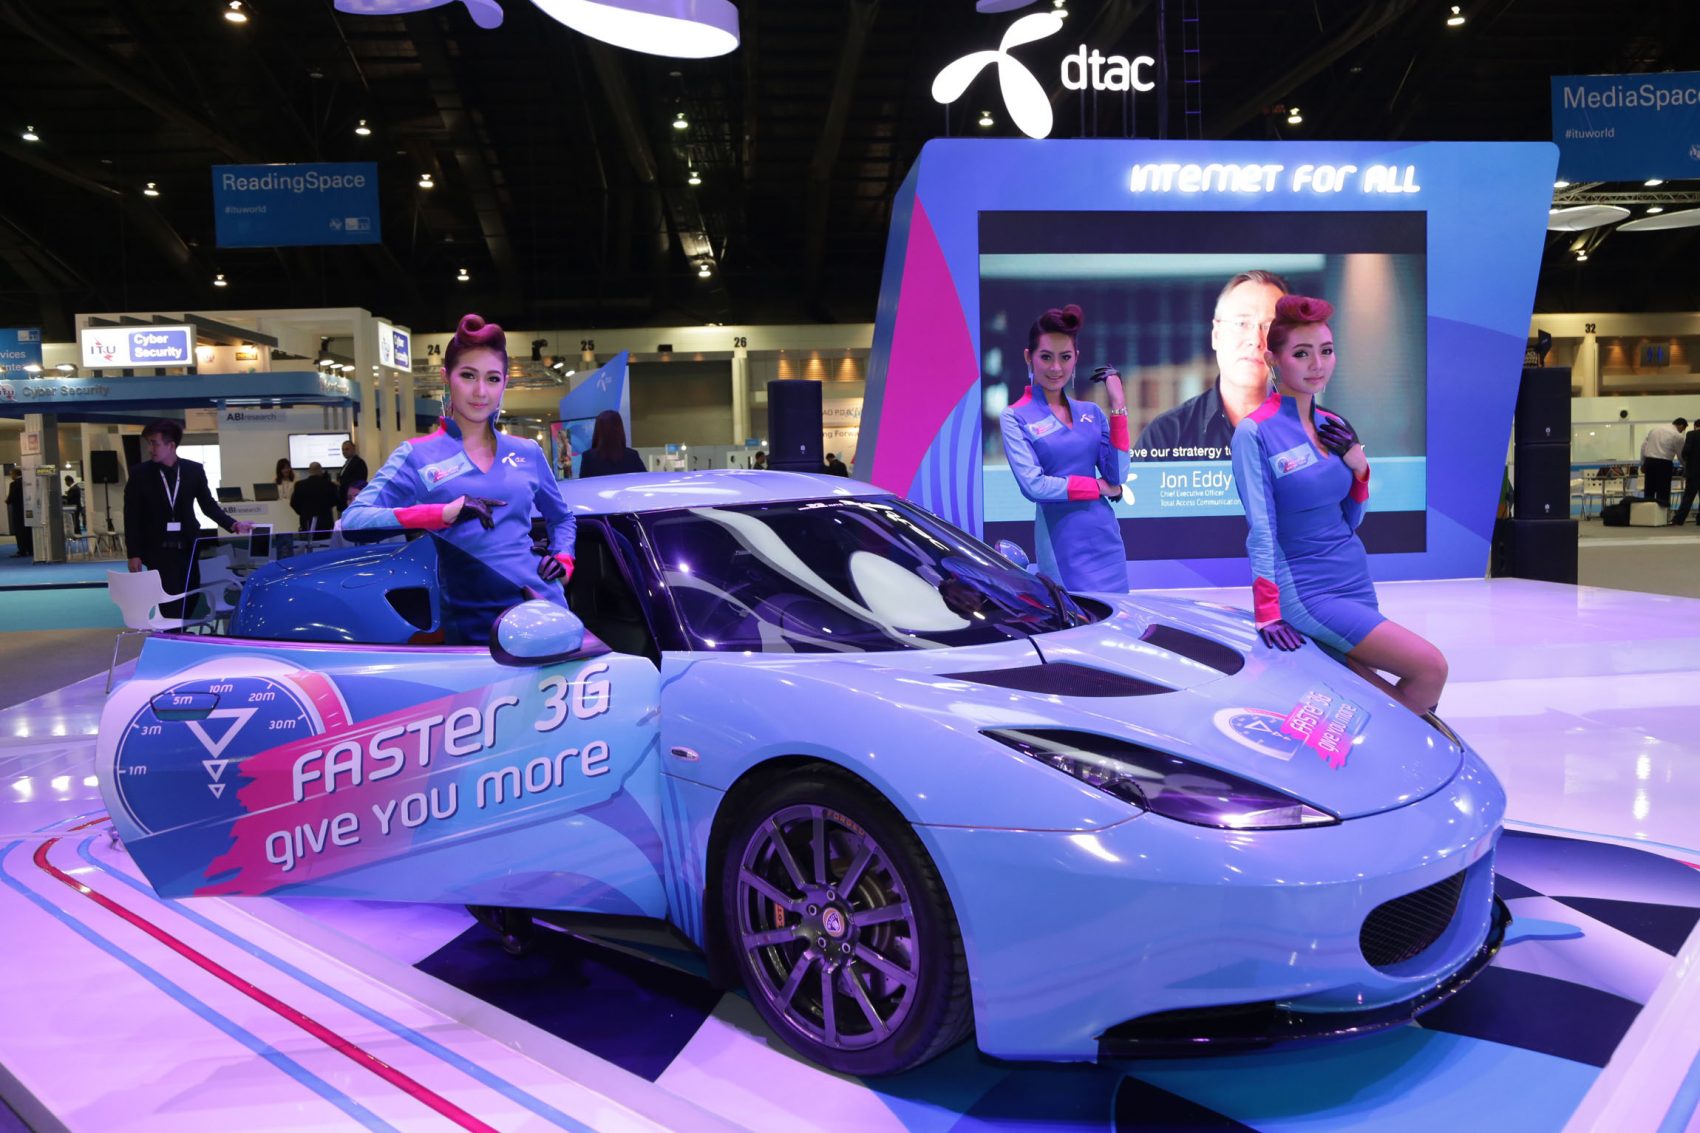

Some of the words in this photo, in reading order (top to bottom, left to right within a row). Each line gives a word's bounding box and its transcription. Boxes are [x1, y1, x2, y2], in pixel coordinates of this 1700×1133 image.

[1061, 44, 1156, 92] dtac
[1563, 84, 1700, 111] MediaSpac
[1565, 128, 1615, 139] #ituworld
[222, 172, 366, 193] ReadingSpace
[1363, 164, 1421, 194] ALL
[224, 205, 267, 214] #ituworld
[1585, 323, 1596, 333] 32
[134, 334, 169, 345] Cyber
[581, 340, 595, 350] 25
[734, 337, 747, 347] 26
[90, 345, 116, 355] ITU
[134, 347, 183, 359] Security
[427, 344, 441, 356] 24
[23, 386, 56, 398] Cyber
[60, 384, 110, 397] Security
[226, 412, 277, 421] ABIresearch
[1150, 448, 1171, 457] our
[1172, 446, 1222, 459] stratergy
[1160, 472, 1188, 489] Jon
[1192, 470, 1233, 491] Eddy
[209, 684, 233, 694] 10m
[173, 695, 193, 705] 5m
[248, 692, 276, 702] 20m
[534, 663, 611, 732] 3G
[268, 719, 297, 730] 30m
[140, 725, 162, 736] 3m
[129, 765, 147, 776] 1m
[476, 740, 612, 808] more
